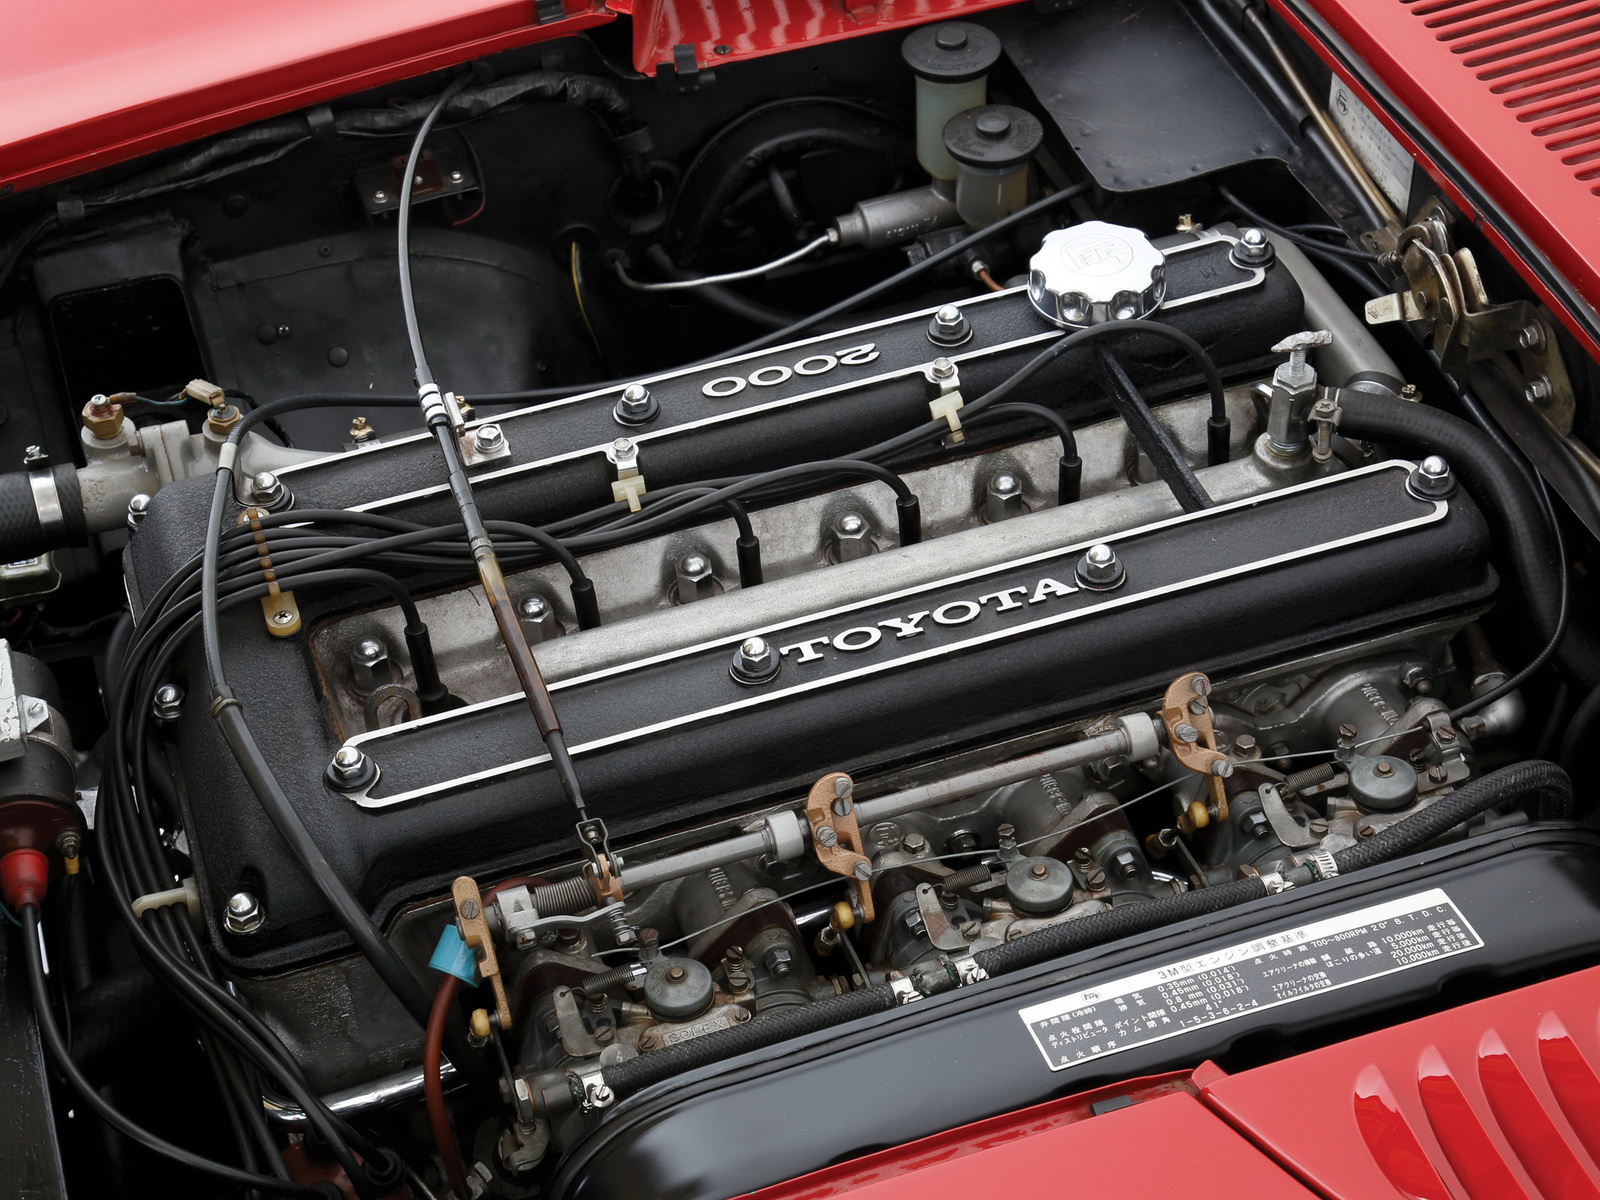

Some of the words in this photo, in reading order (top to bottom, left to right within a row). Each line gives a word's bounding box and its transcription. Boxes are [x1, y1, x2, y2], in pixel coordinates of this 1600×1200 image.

[702, 343, 880, 397] 2000
[779, 577, 1079, 663] TOYOTA
[669, 1020, 724, 1042] SOLEX
